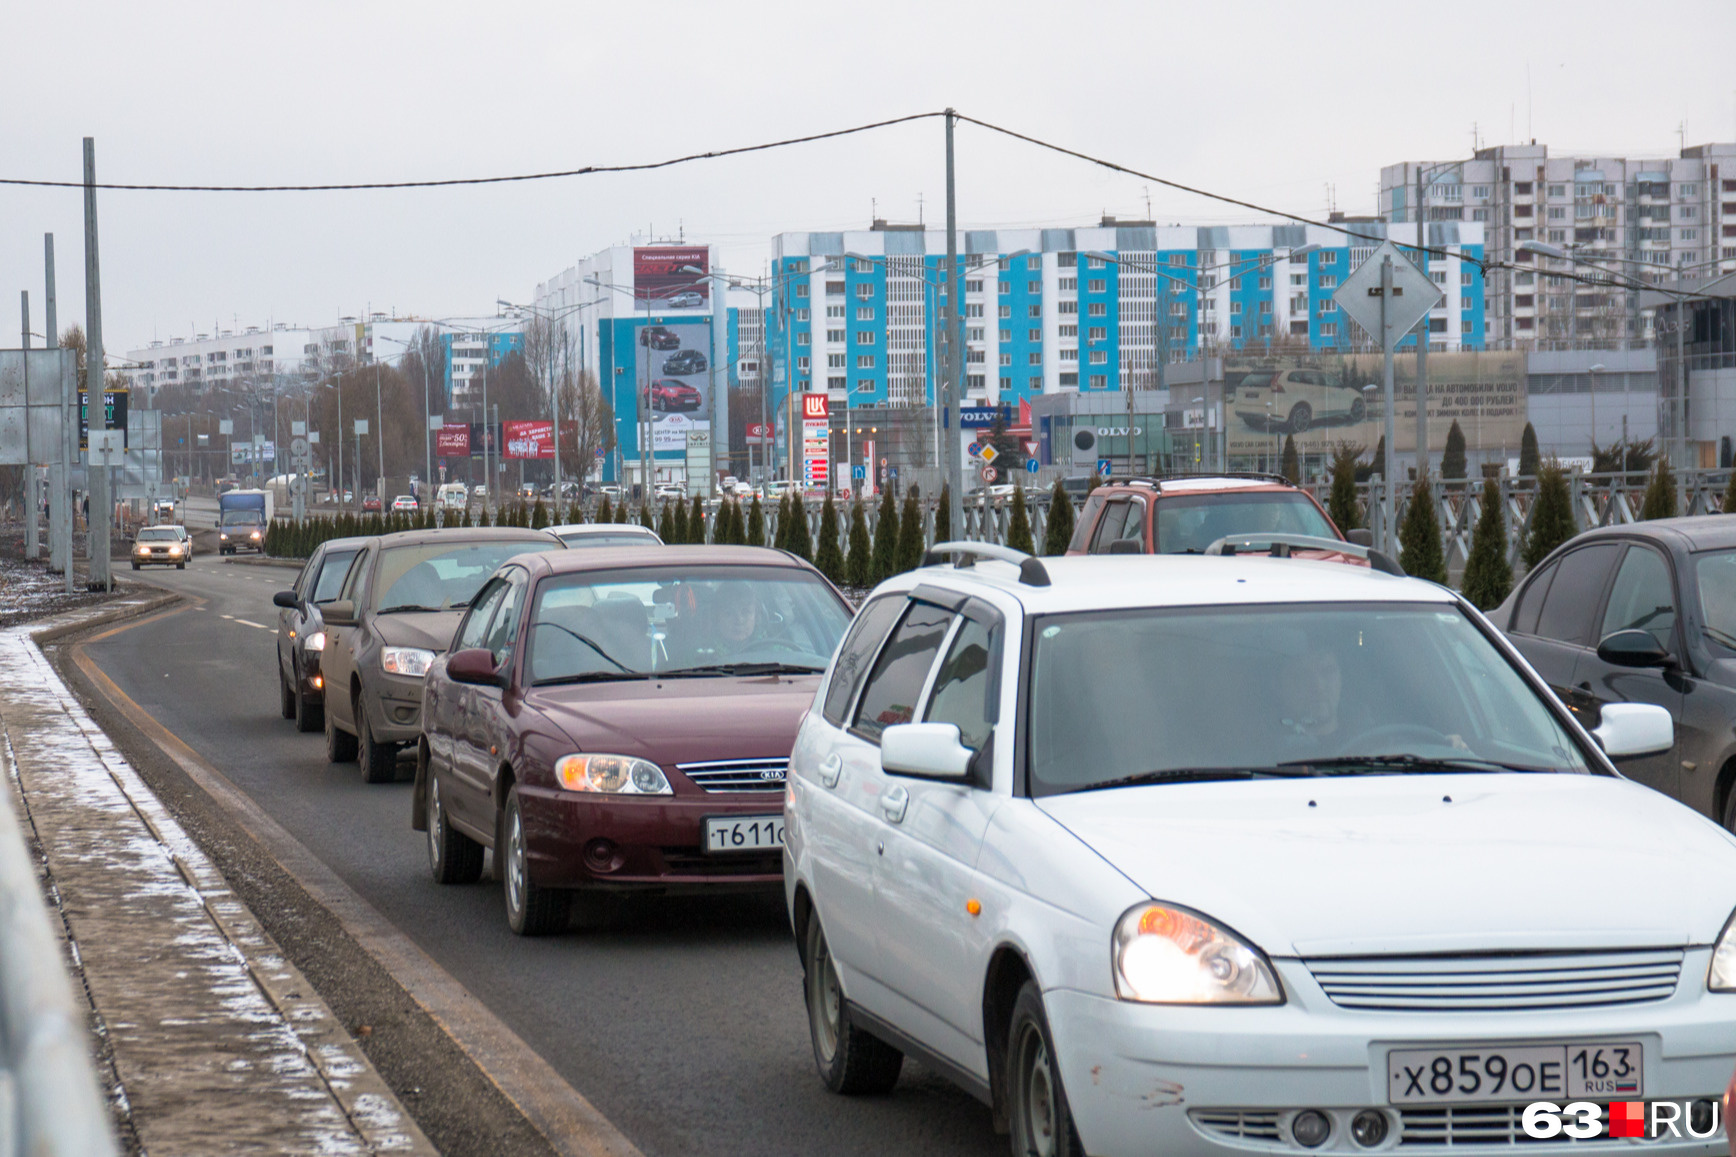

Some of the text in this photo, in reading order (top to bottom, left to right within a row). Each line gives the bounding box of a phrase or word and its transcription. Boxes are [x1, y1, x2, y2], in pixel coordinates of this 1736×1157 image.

[1435, 385, 1445, 393] НА
[1446, 383, 1494, 393] АВТОМОБИЛИ
[1496, 382, 1518, 392] VOLVO
[1442, 397, 1453, 407] ДО
[763, 771, 782, 781] KIA
[1572, 1048, 1631, 1080] 163
[1584, 1079, 1615, 1093] RUS
